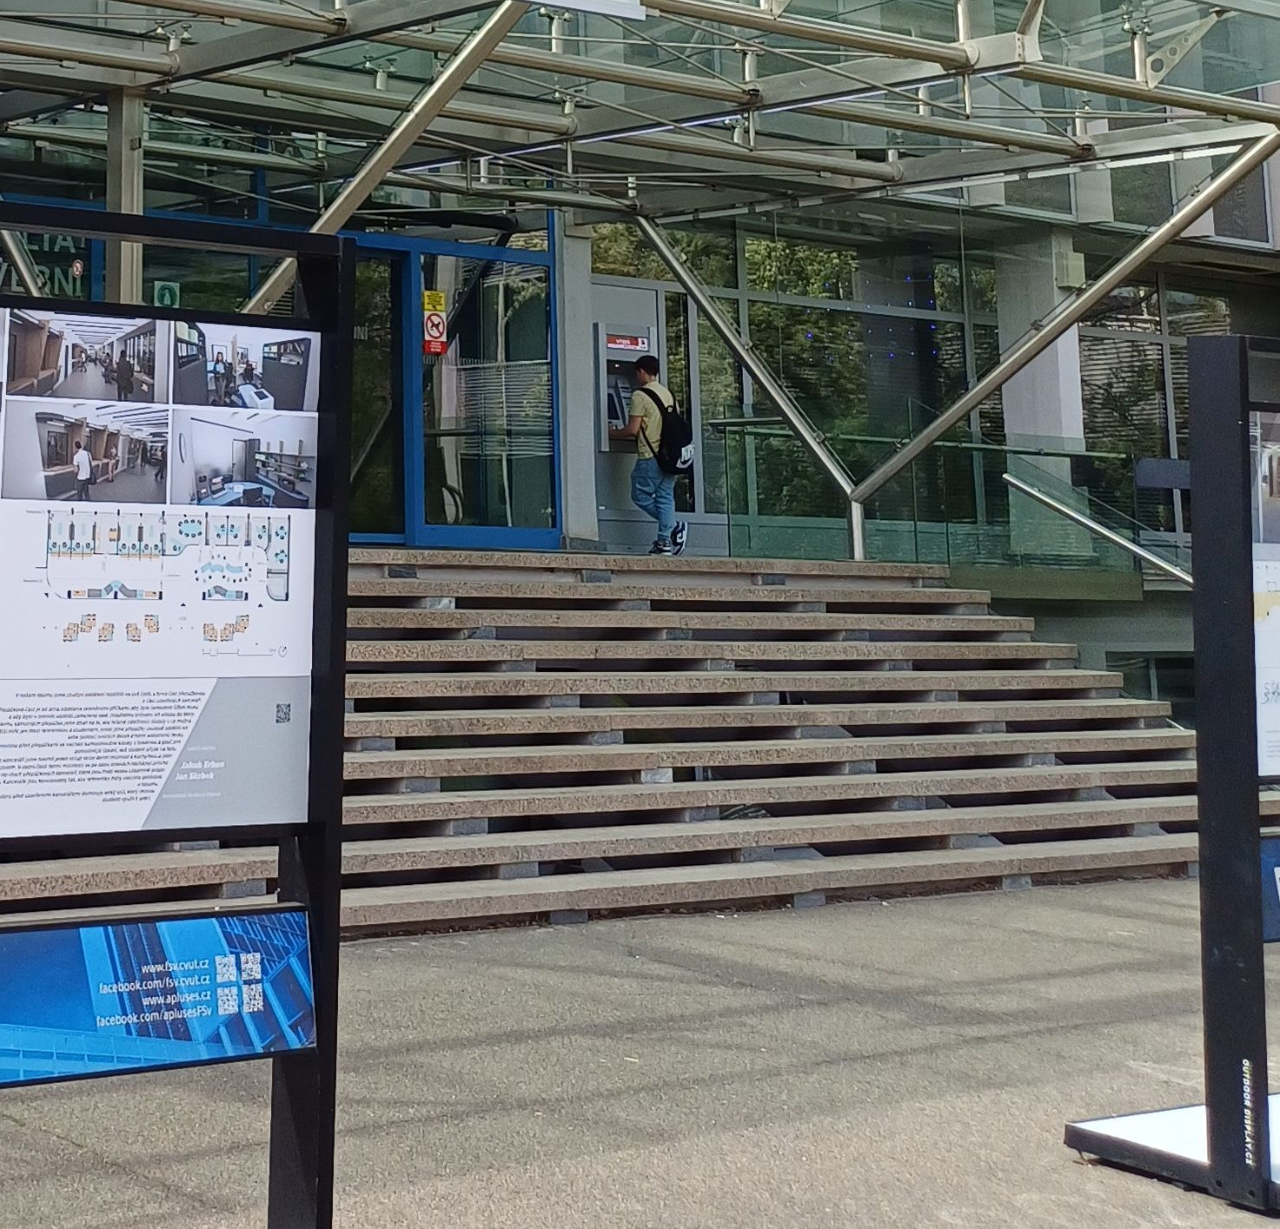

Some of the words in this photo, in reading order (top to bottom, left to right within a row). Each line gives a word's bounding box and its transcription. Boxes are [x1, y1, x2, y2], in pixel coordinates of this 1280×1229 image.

[141, 958, 210, 974] www.fsv.cvut.cz
[99, 975, 211, 994] facebook.com/fsv.cvut.cz
[142, 990, 211, 1006] www.apluses.cz
